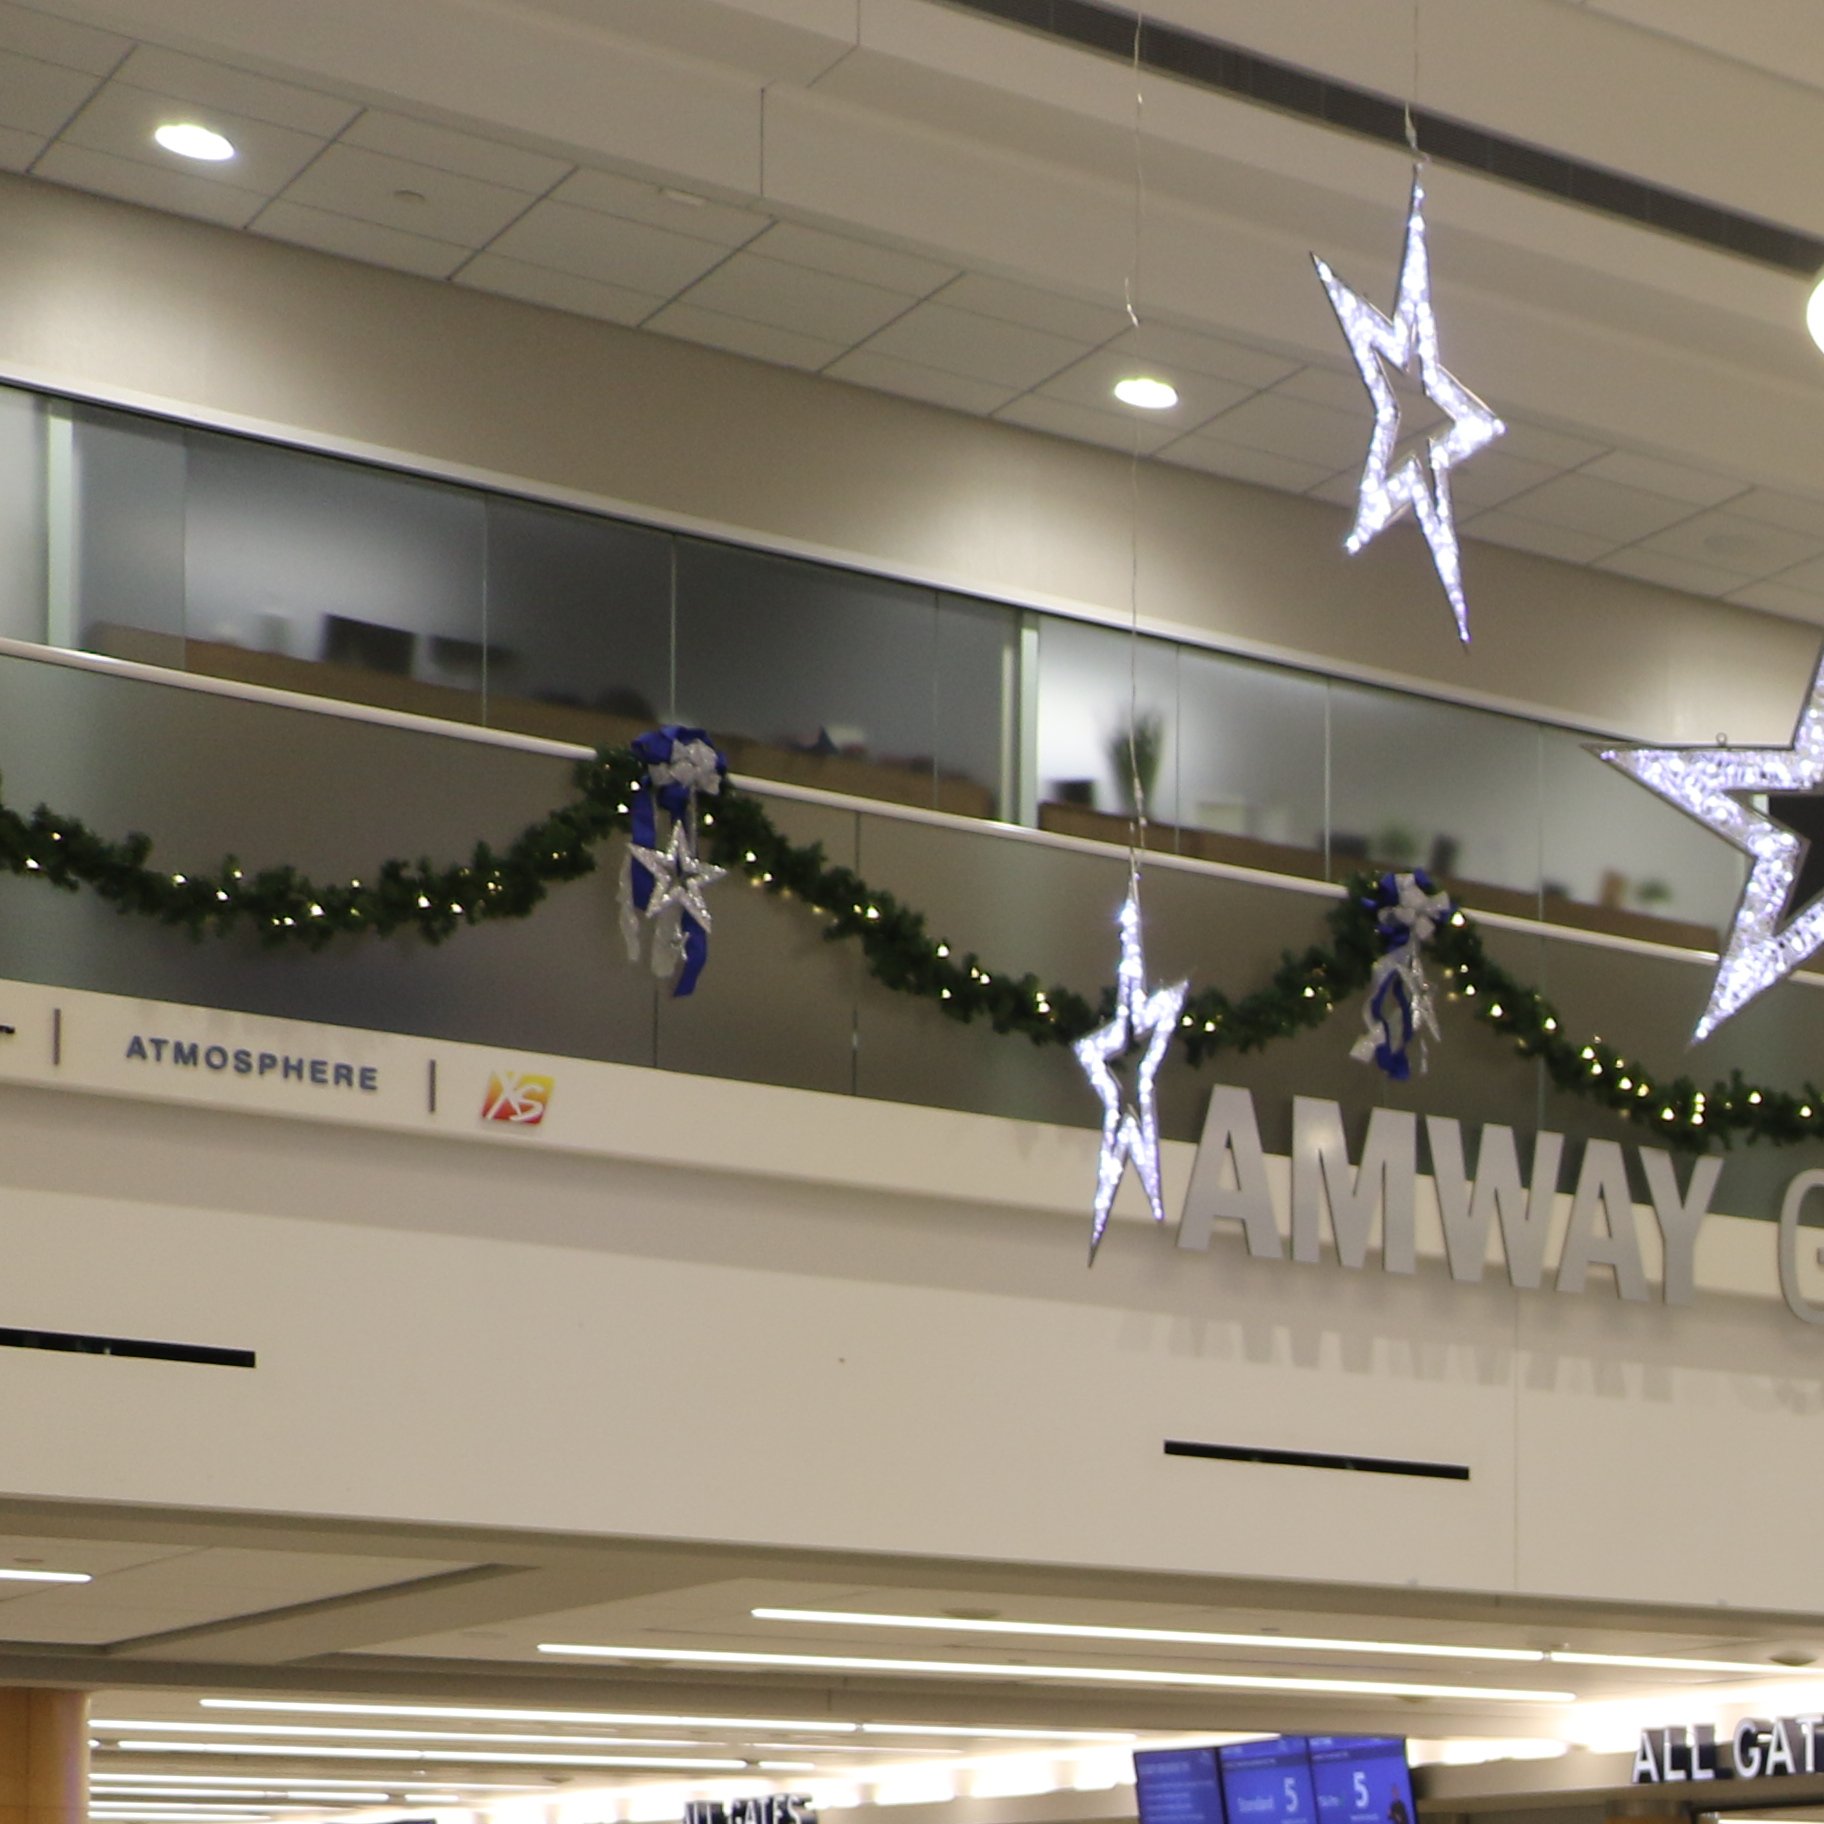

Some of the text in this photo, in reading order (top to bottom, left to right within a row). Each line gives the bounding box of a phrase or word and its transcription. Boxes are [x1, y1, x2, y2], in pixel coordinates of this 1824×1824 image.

[126, 1035, 378, 1091] ATMOSPHERE
[1178, 1084, 1723, 1305] AMWAY
[1633, 1728, 1714, 1783] ALL
[1283, 1776, 1298, 1813] 5
[1353, 1771, 1369, 1808] 5
